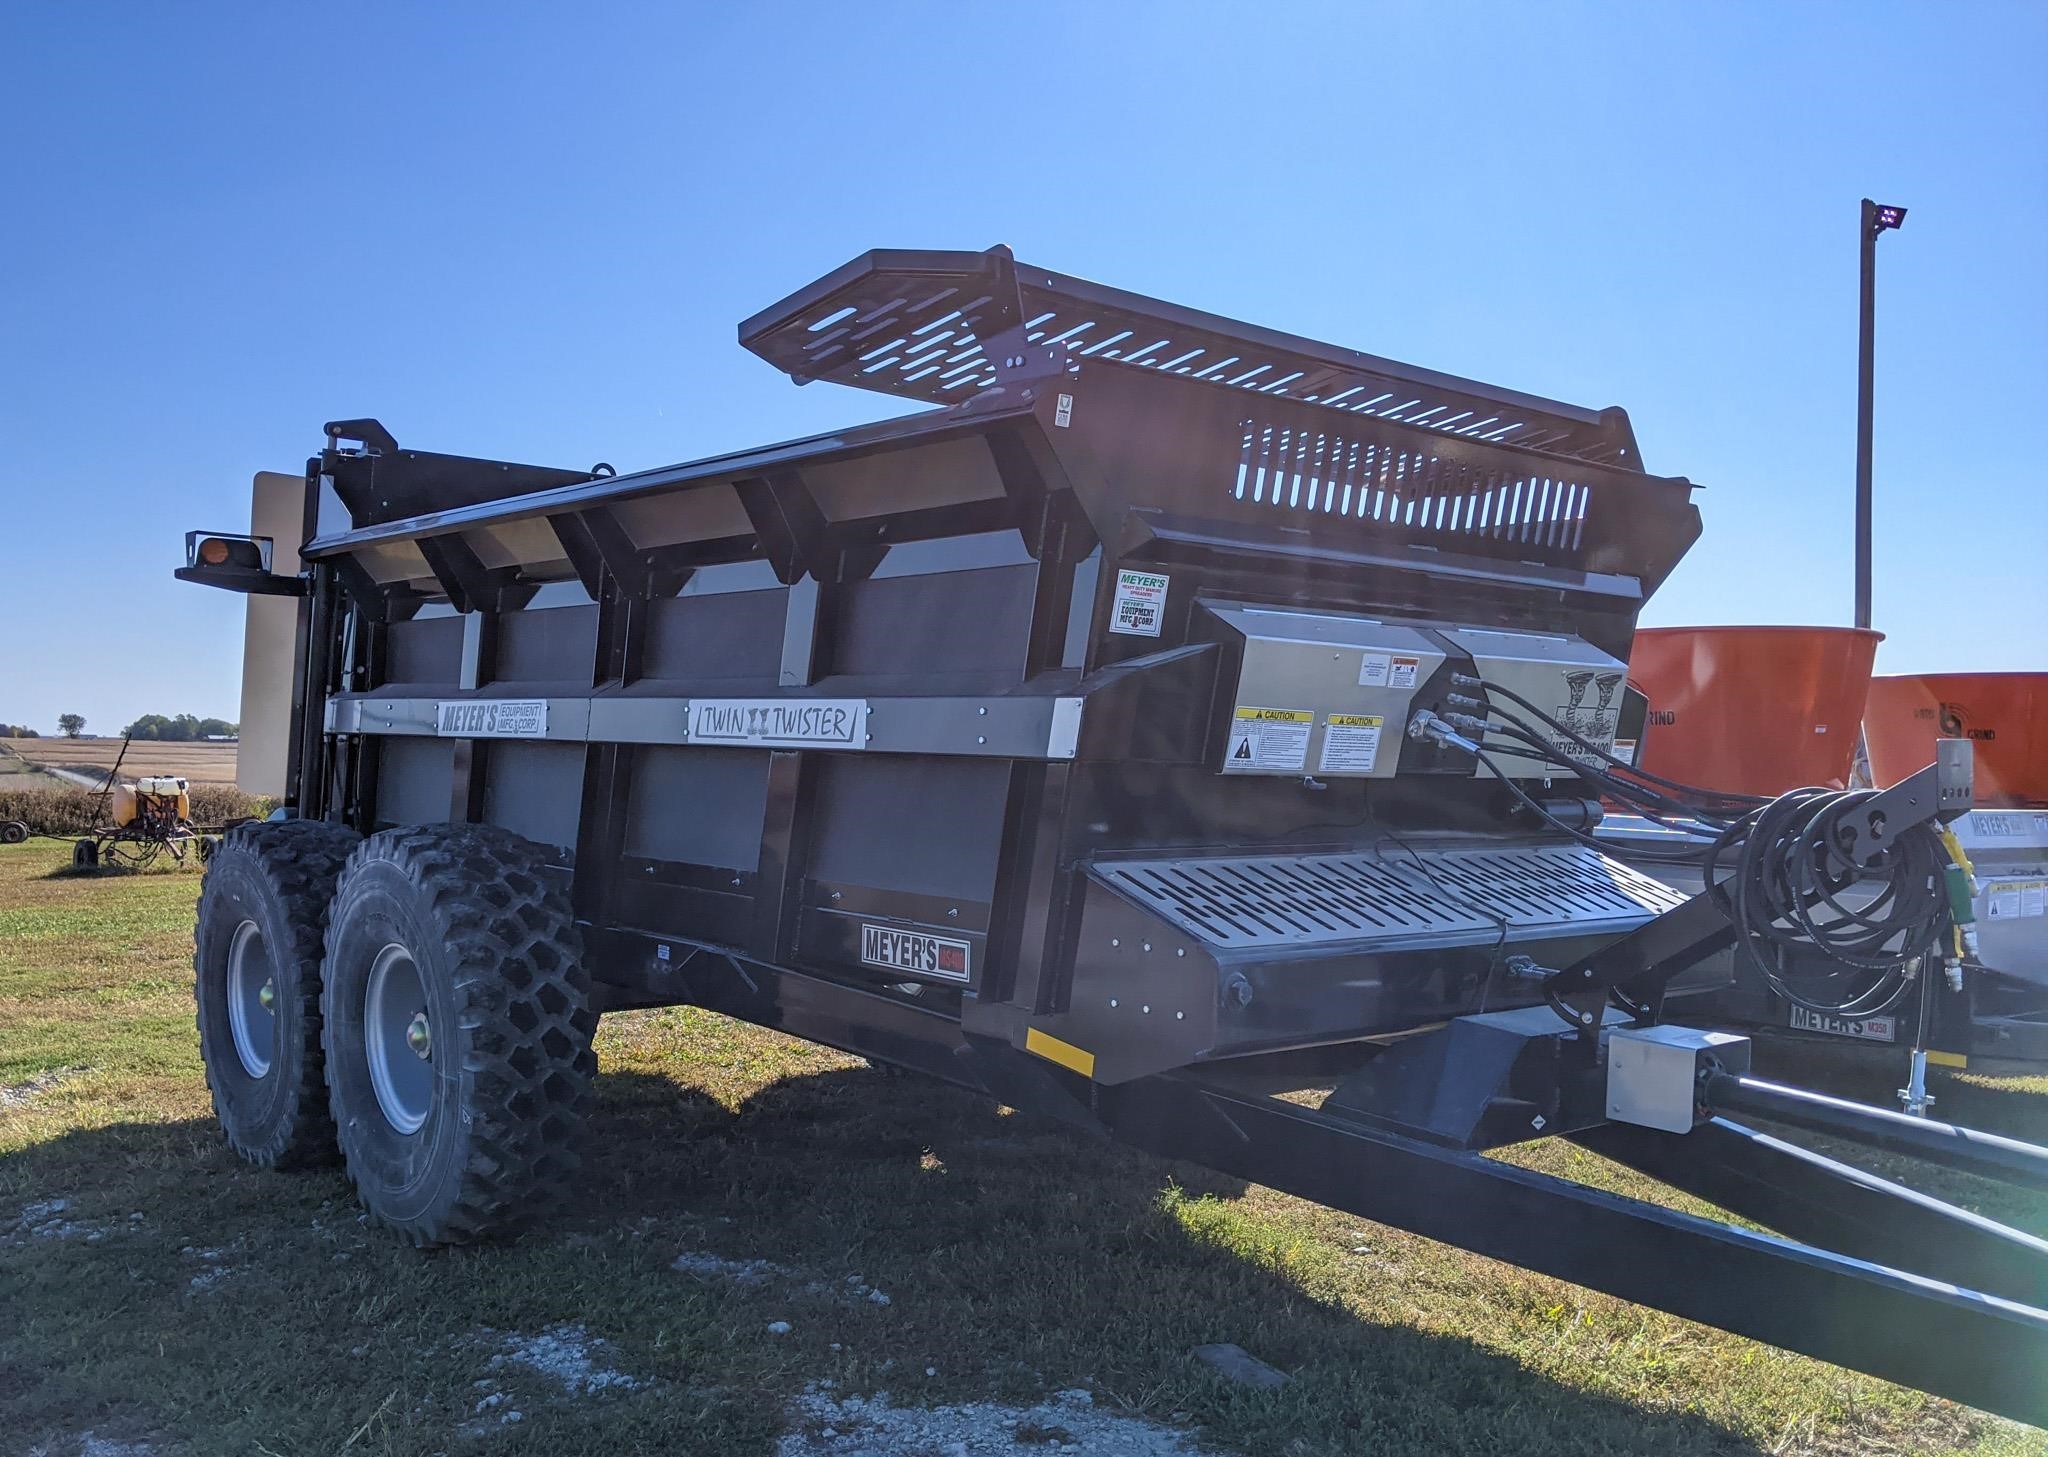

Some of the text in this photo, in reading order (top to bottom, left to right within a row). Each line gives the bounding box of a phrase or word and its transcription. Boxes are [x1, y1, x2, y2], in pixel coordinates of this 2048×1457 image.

[1121, 574, 1165, 588] MEYER'S
[1121, 606, 1154, 617] EQUIPMENT
[1138, 617, 1154, 626] CORP.
[442, 705, 539, 732] MEYER'S EQUIPMENT
[704, 707, 846, 737] TWIN TWISTER
[1264, 710, 1296, 720] CAUTION
[1346, 717, 1374, 725] CAUTION
[1649, 711, 1675, 726] RIND
[866, 929, 936, 970] MEYER'S
